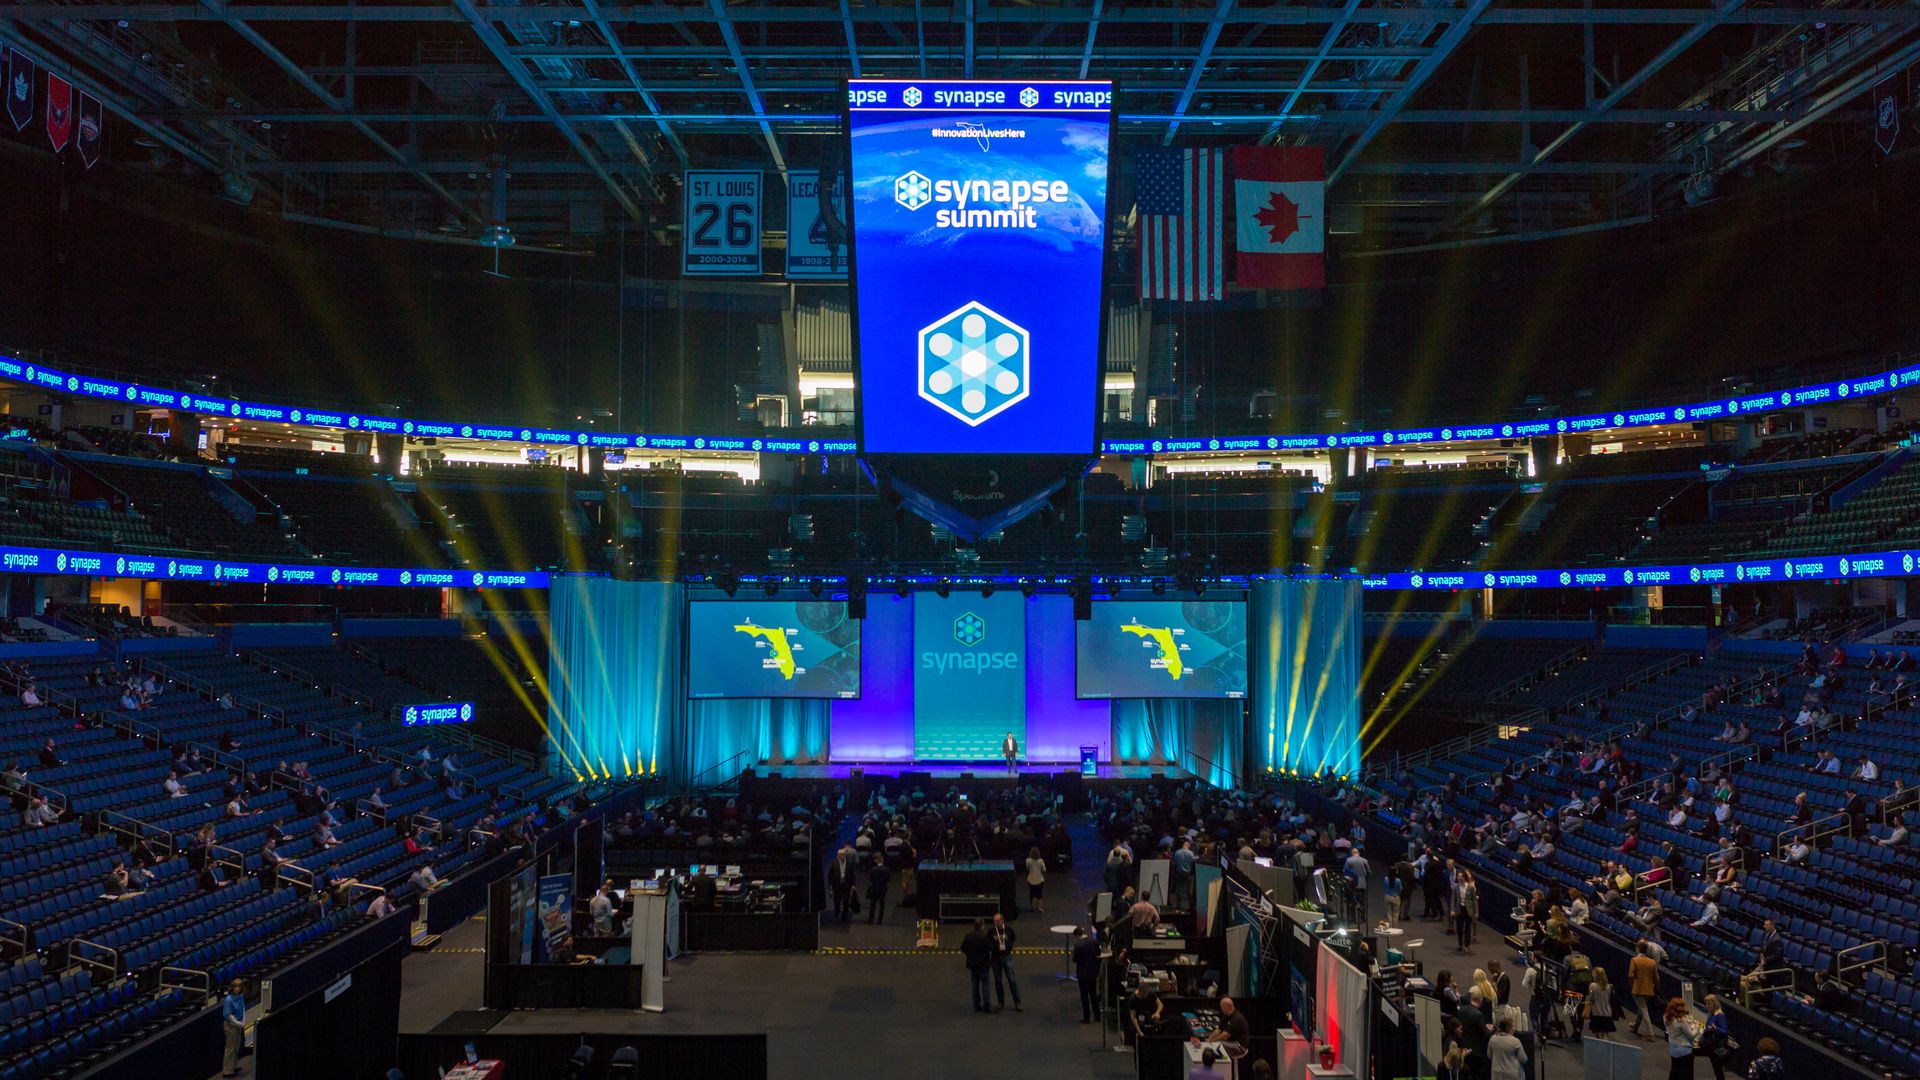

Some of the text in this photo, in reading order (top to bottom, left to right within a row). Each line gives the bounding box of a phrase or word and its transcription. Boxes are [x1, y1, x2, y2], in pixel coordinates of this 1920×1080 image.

[848, 89, 1111, 108] apse synapse synaps
[931, 128, 1026, 138] #InnovationLivesHere
[694, 181, 755, 197] ST. LOUIS
[934, 179, 1069, 209] synapse
[693, 202, 754, 248] 26
[936, 205, 1037, 228] summit
[699, 255, 747, 264] 2000-2014
[801, 257, 847, 265] 1998-213
[0, 361, 22, 376] napse
[36, 371, 63, 386] synapse
[83, 381, 119, 396] synapse
[140, 390, 175, 405] synapse
[194, 399, 226, 413] synapse
[244, 407, 283, 420] synapse
[305, 413, 342, 426] synapse
[362, 419, 398, 431] synapse
[416, 424, 454, 436] synapse
[476, 428, 514, 441] synapse
[535, 432, 571, 443] synapse
[591, 435, 629, 447] synapse
[650, 438, 687, 449] synapse
[709, 438, 745, 450] synapse
[766, 441, 802, 452] synapse
[1109, 369, 1920, 453] synapse synapse synapse synapse synapse synapse synapse synapse synapse synapse synapse synapse synapse synapse synap
[3, 553, 527, 587] synapse synapse synapse synapse synapse synapse synapse synapse synapse
[1427, 576, 1465, 588] synapse
[1499, 574, 1538, 587] synapse
[1575, 573, 1607, 585] synapse
[1636, 571, 1671, 584] synapse
[1701, 568, 1725, 582] synapse
[1745, 565, 1772, 580] synapse
[1795, 562, 1824, 578] synapse
[1851, 559, 1885, 575] synapse
[922, 651, 1018, 675] synapse
[421, 707, 458, 724] synapse
